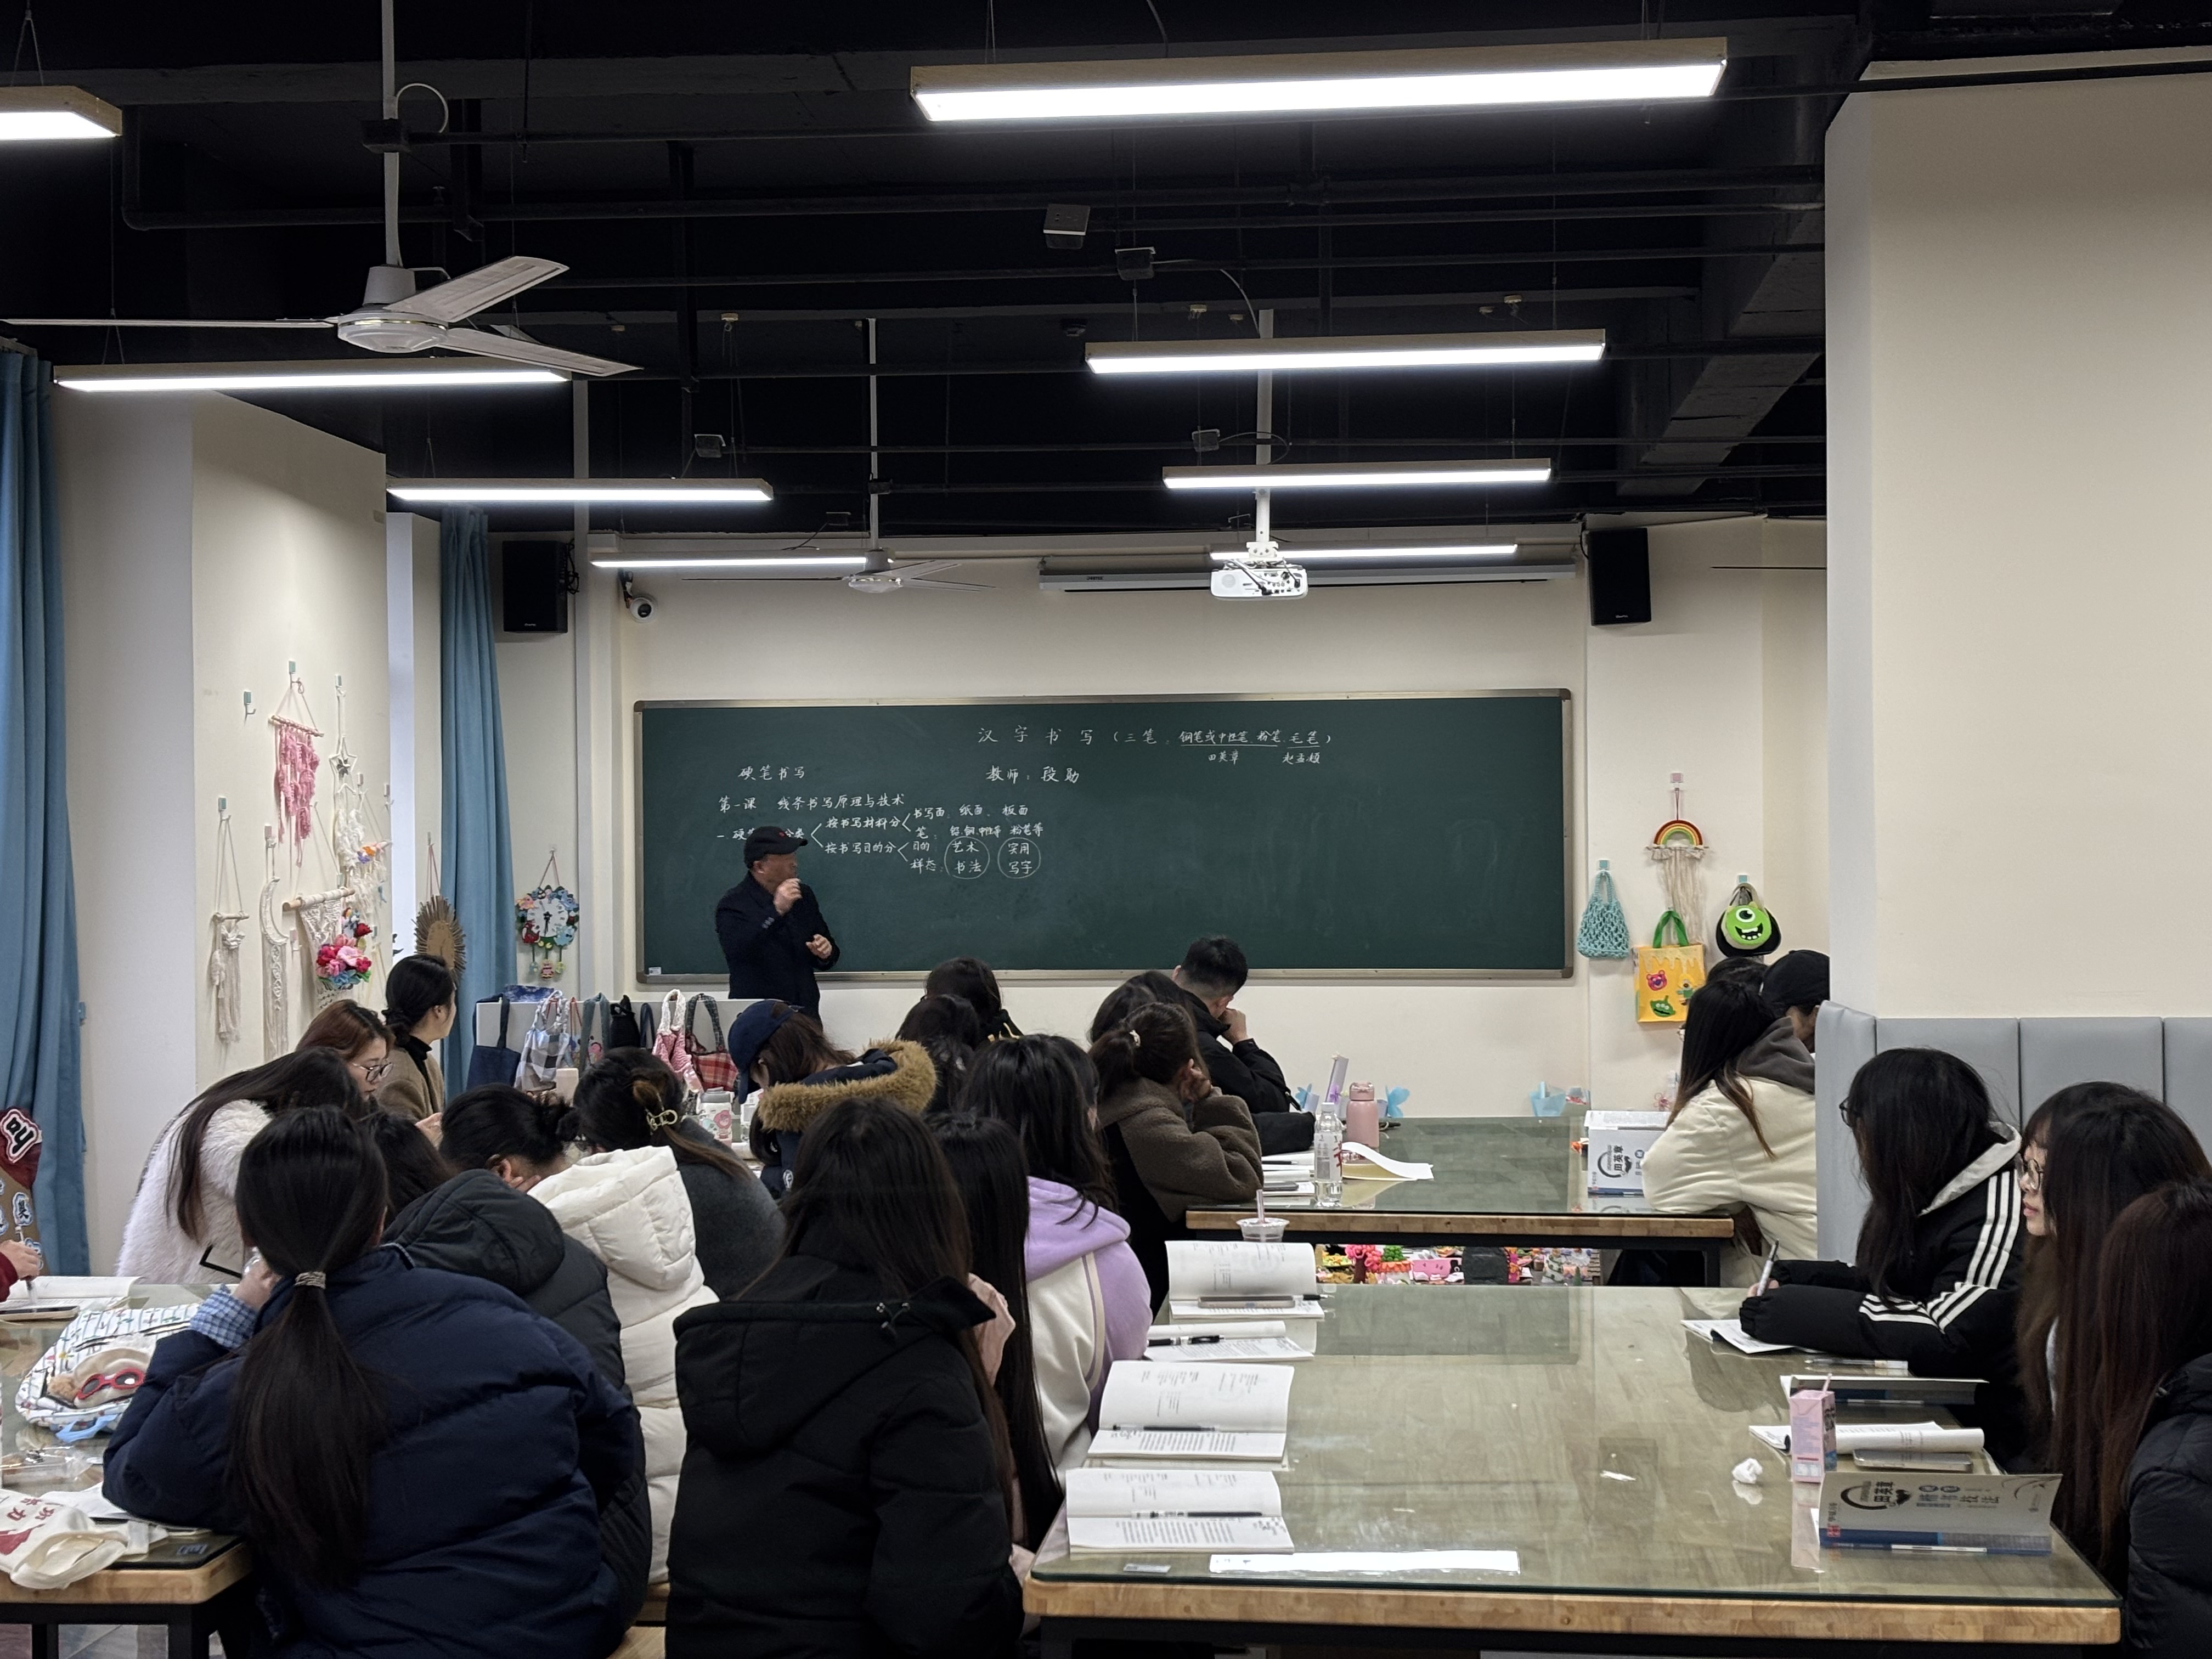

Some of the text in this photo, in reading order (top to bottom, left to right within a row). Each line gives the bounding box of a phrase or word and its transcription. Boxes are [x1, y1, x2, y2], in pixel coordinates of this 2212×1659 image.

[1208, 749, 1239, 765] 田英章
[737, 764, 805, 781] 硬笔书写
[718, 792, 905, 814] 第一课 线条书写原理与技术
[1001, 804, 1029, 816] 板面
[825, 815, 901, 831] 按书写材料分
[824, 840, 898, 855] 按书写目的分
[951, 840, 980, 853] 艺术
[1007, 842, 1030, 855] 实用
[953, 859, 983, 874] 书法
[1008, 860, 1032, 874] 写字
[1613, 1144, 1623, 1171] 田英章
[1874, 1481, 1895, 1503] 田英章
